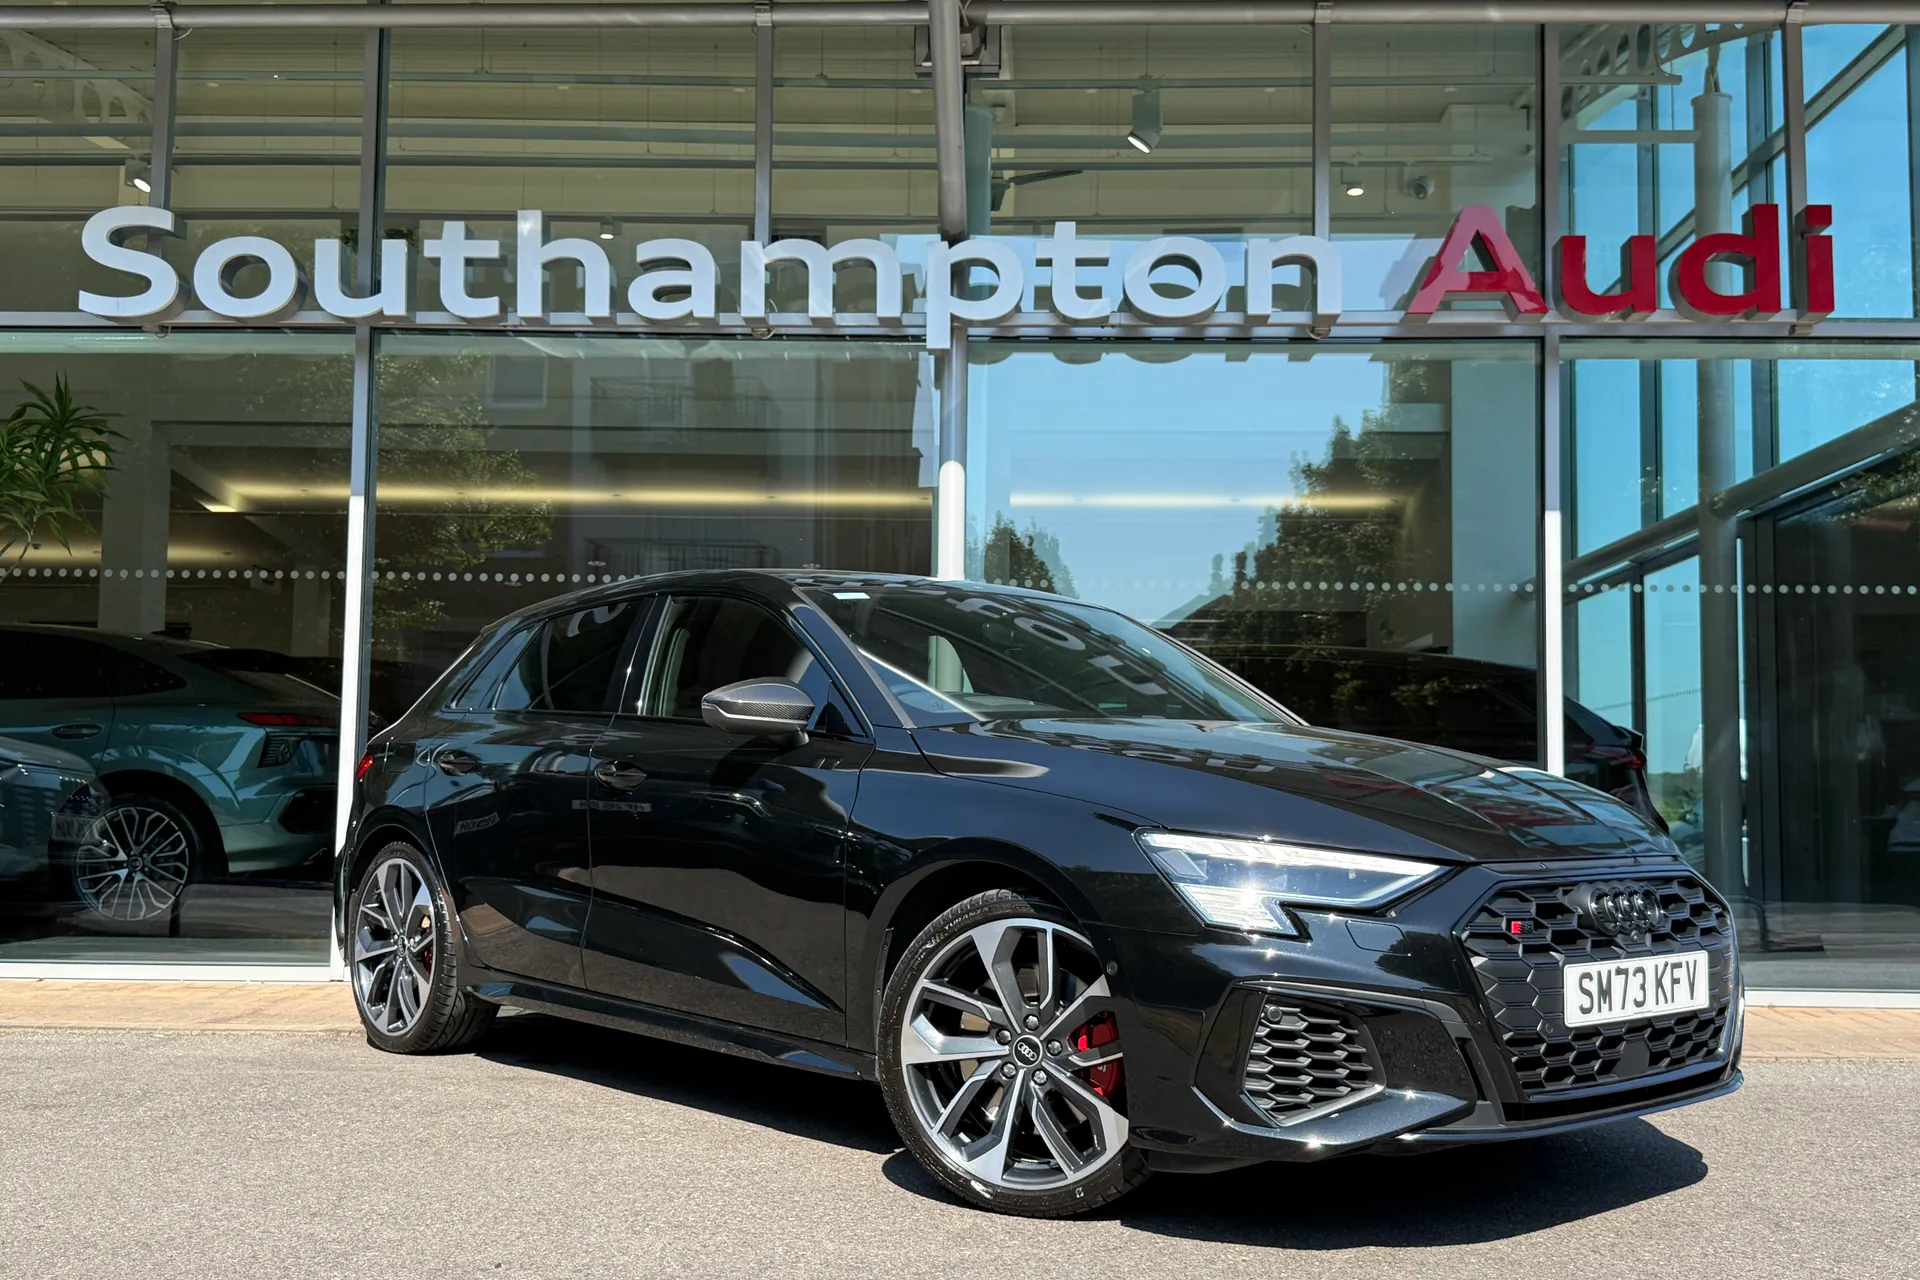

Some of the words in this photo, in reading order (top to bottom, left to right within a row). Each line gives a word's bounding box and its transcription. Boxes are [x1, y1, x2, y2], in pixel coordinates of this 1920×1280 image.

[78, 205, 1343, 351] Southampton
[1406, 204, 1835, 319] Audi
[1578, 965, 1647, 1015] SM73
[1654, 960, 1697, 1006] KFV
